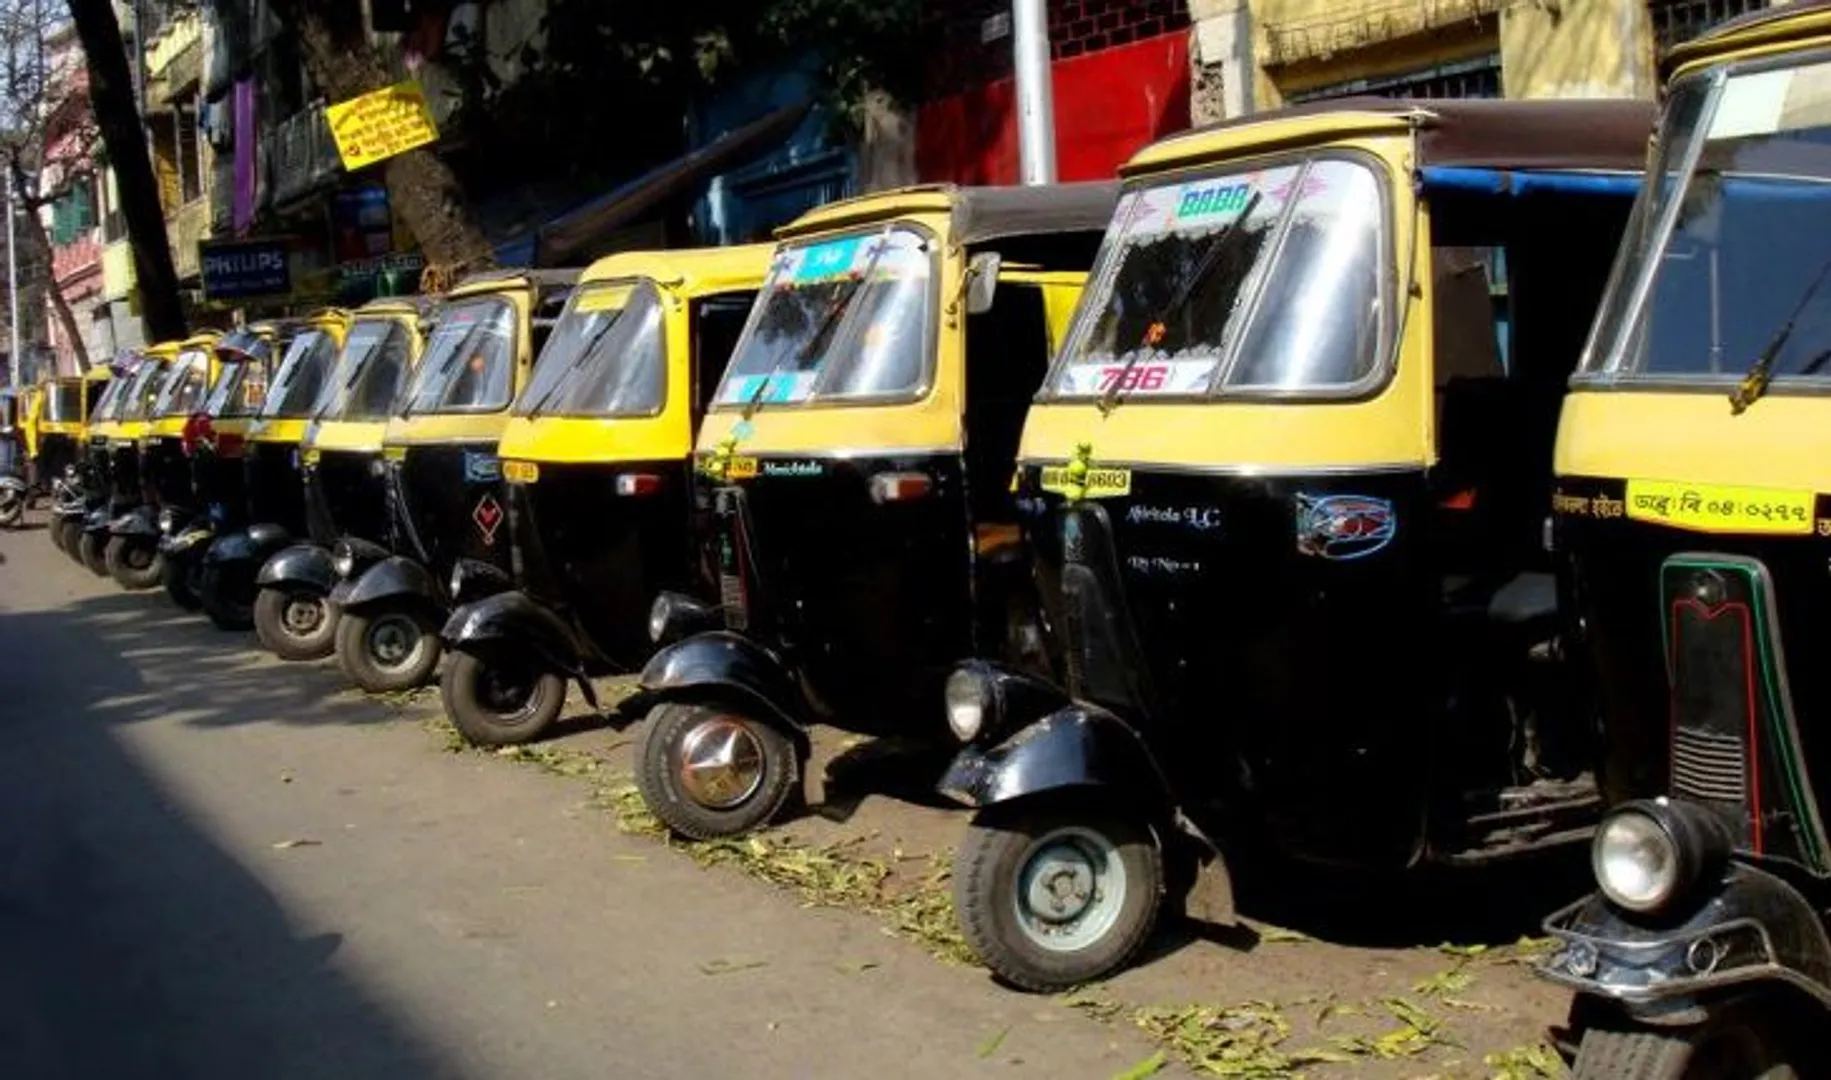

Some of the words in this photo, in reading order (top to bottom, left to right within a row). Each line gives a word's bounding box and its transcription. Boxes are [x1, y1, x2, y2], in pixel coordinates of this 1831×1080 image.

[1178, 183, 1249, 217] BABA
[203, 251, 284, 276] PHILIPS
[1099, 366, 1168, 391] 786
